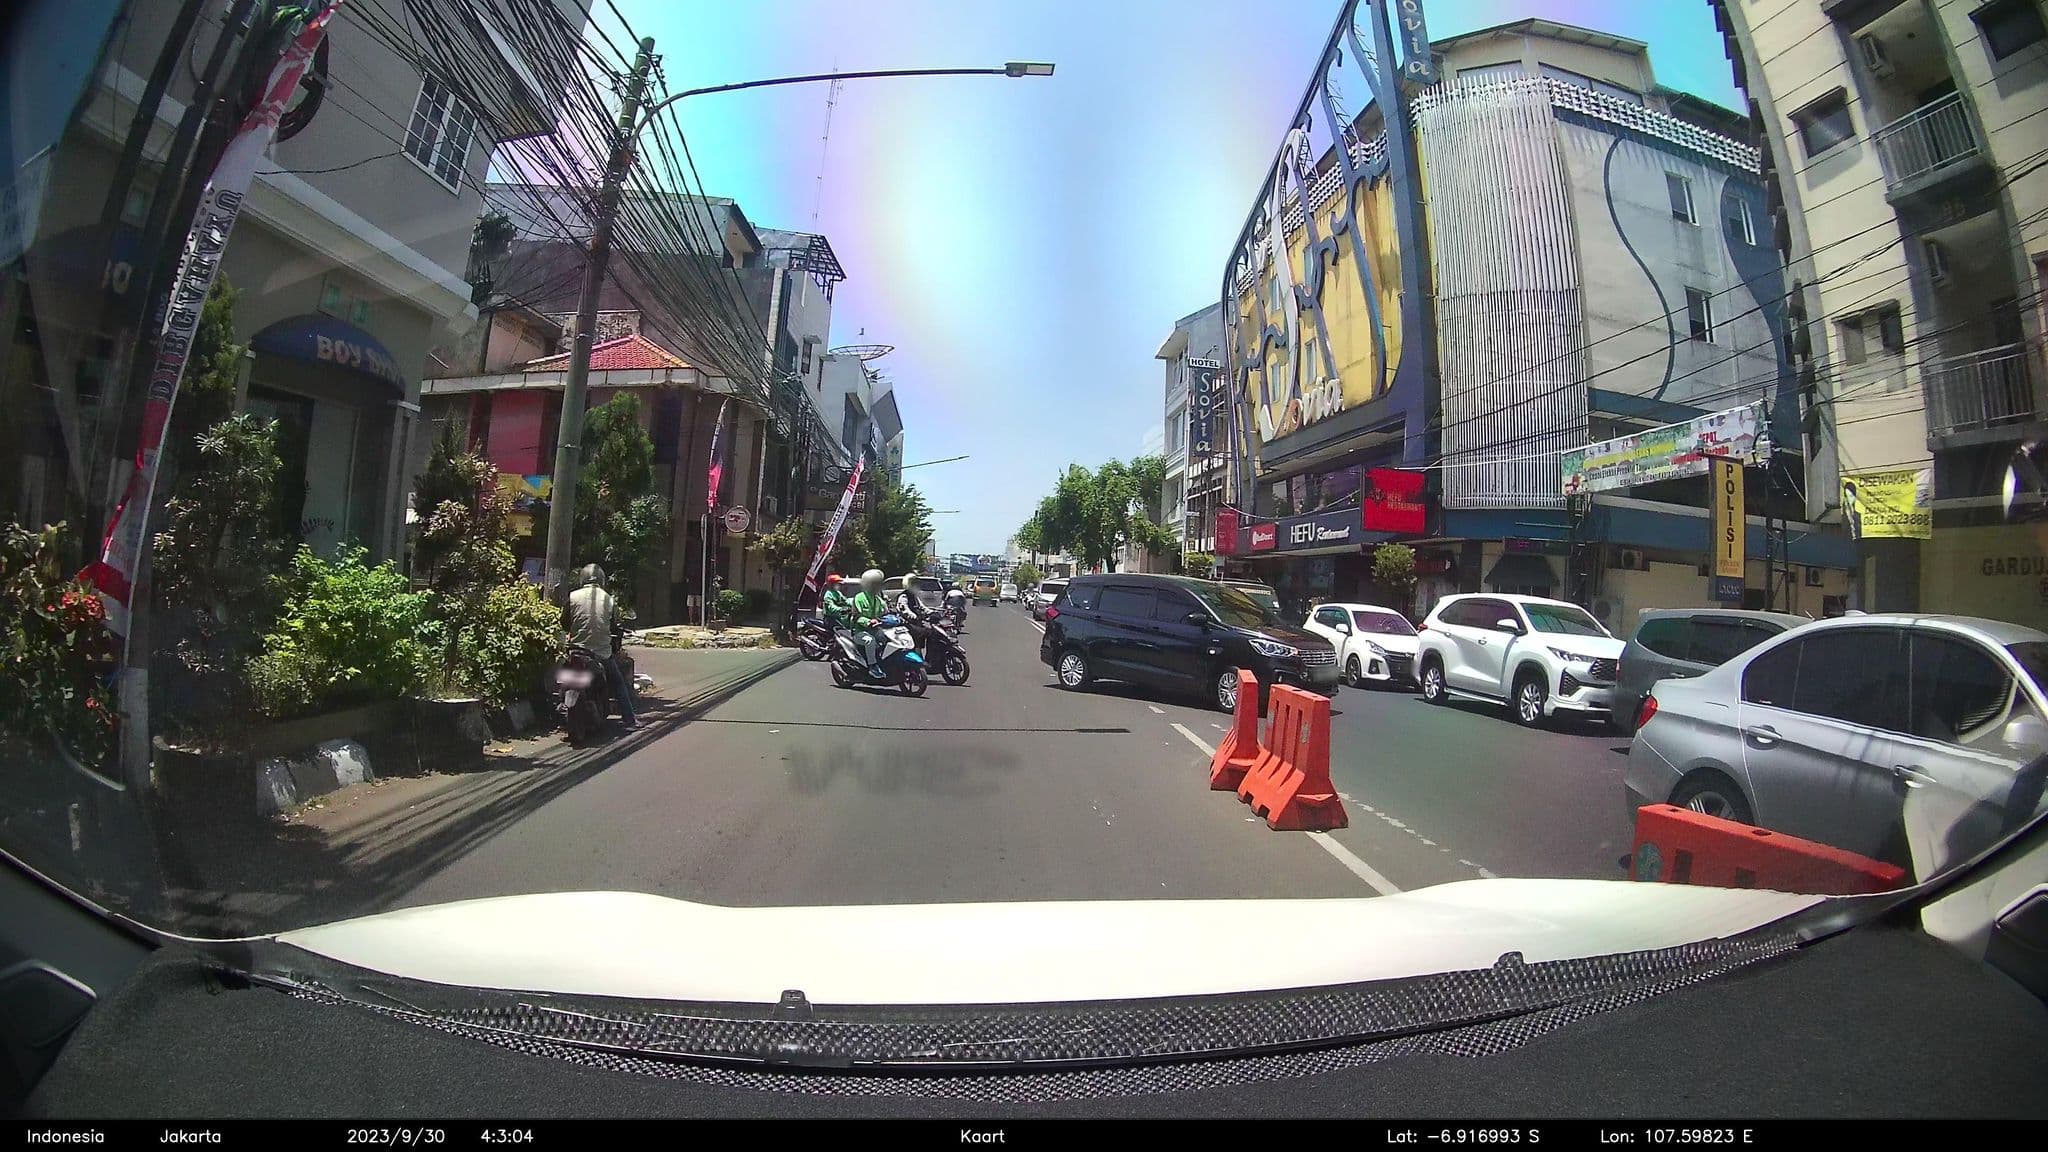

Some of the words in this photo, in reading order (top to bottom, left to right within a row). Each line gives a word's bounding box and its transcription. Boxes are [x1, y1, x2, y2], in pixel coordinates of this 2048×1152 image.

[316, 335, 361, 368] BOY
[1190, 357, 1219, 368] HOTEL
[1196, 372, 1211, 452] Sovia
[1859, 472, 1914, 487] DISEWAKAN
[1725, 463, 1735, 559] POLISI
[1290, 522, 1316, 544] HEFU
